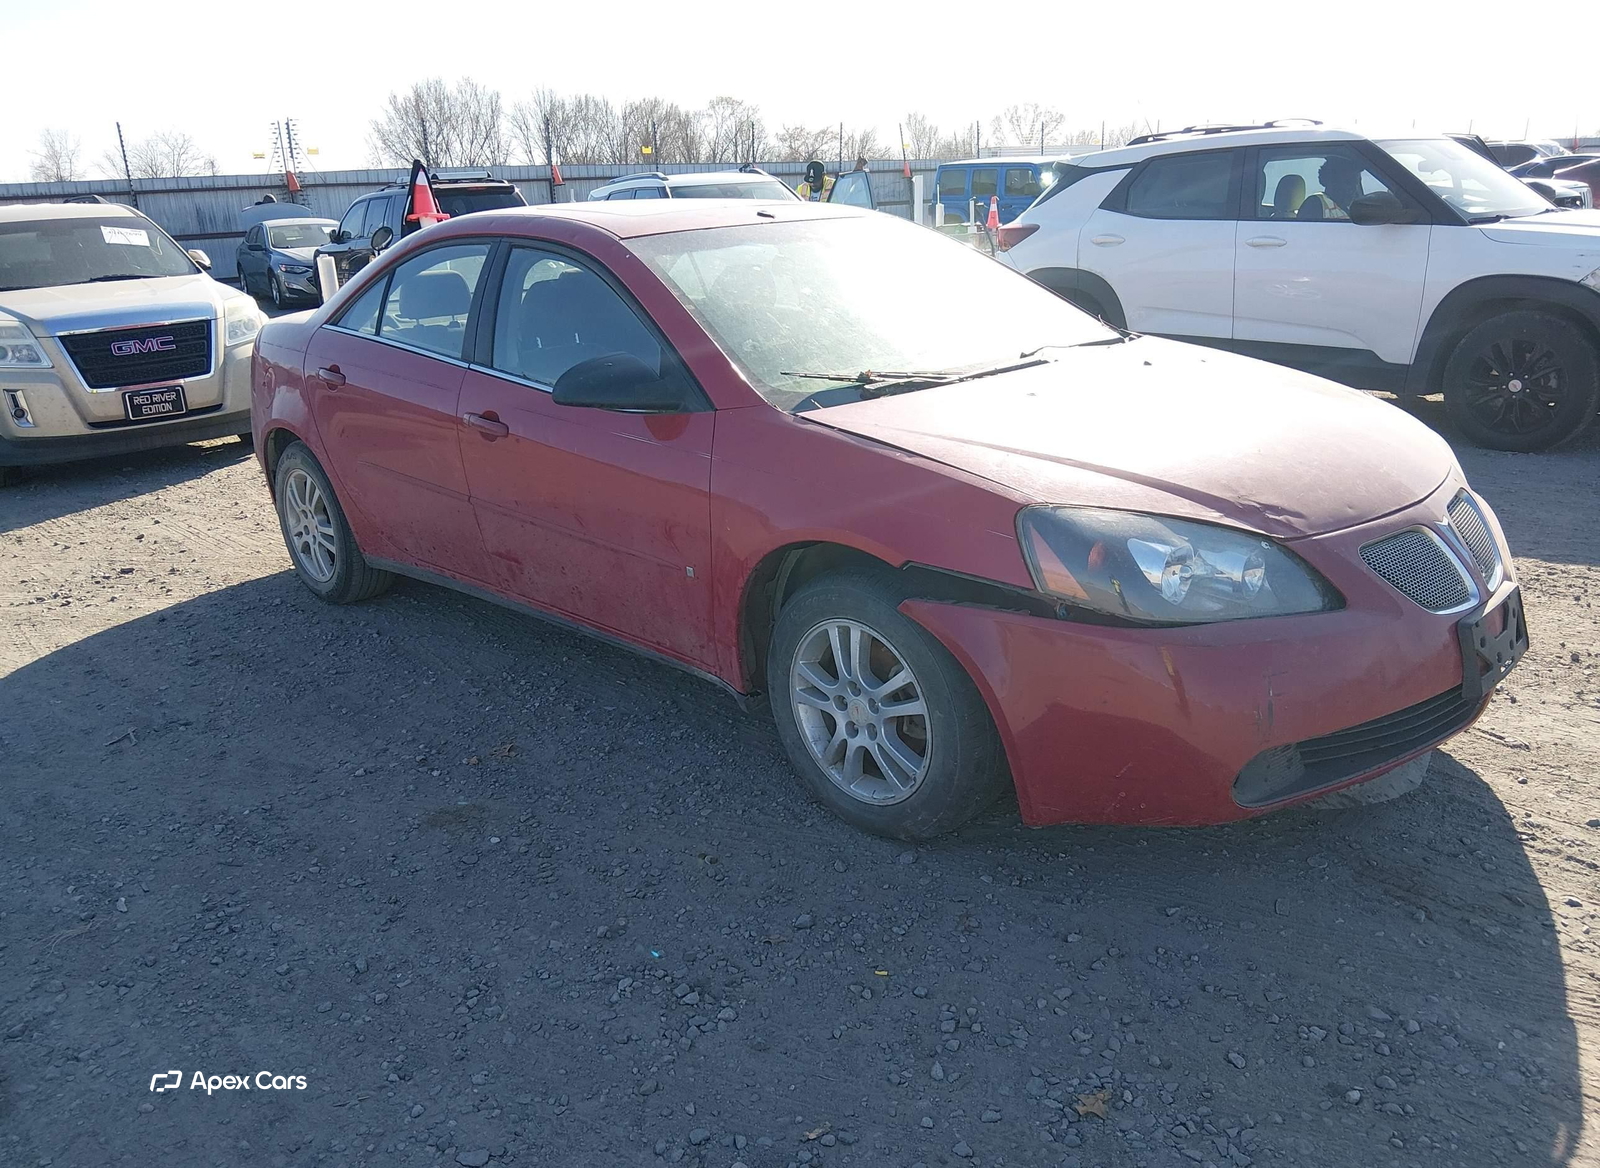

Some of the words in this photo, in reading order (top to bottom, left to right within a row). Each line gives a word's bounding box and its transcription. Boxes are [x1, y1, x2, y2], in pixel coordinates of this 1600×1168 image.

[111, 336, 176, 356] GMC
[133, 395, 151, 405] RED
[152, 392, 177, 403] RIVER
[142, 402, 173, 415] EDITION
